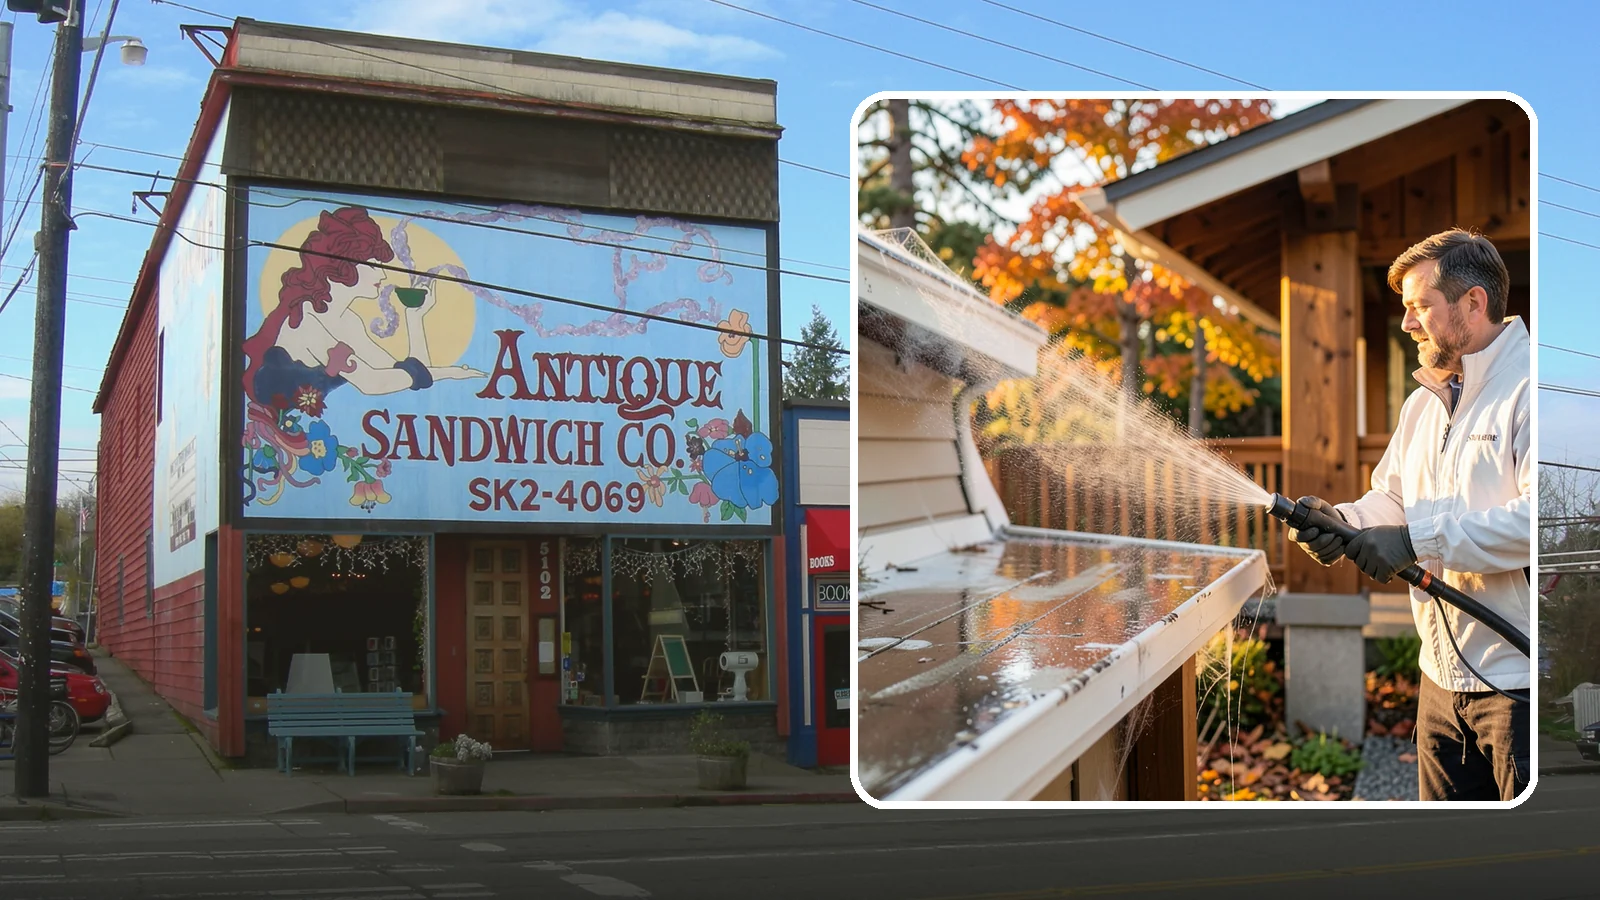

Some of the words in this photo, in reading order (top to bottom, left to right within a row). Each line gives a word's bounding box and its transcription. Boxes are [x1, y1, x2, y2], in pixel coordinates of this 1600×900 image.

[476, 329, 723, 420] ANTIQUE
[362, 409, 605, 467] SANDWICH
[617, 420, 685, 469] CO.
[468, 477, 646, 512] SK2-4069
[540, 542, 551, 600] 5102
[809, 555, 835, 569] BOOKS
